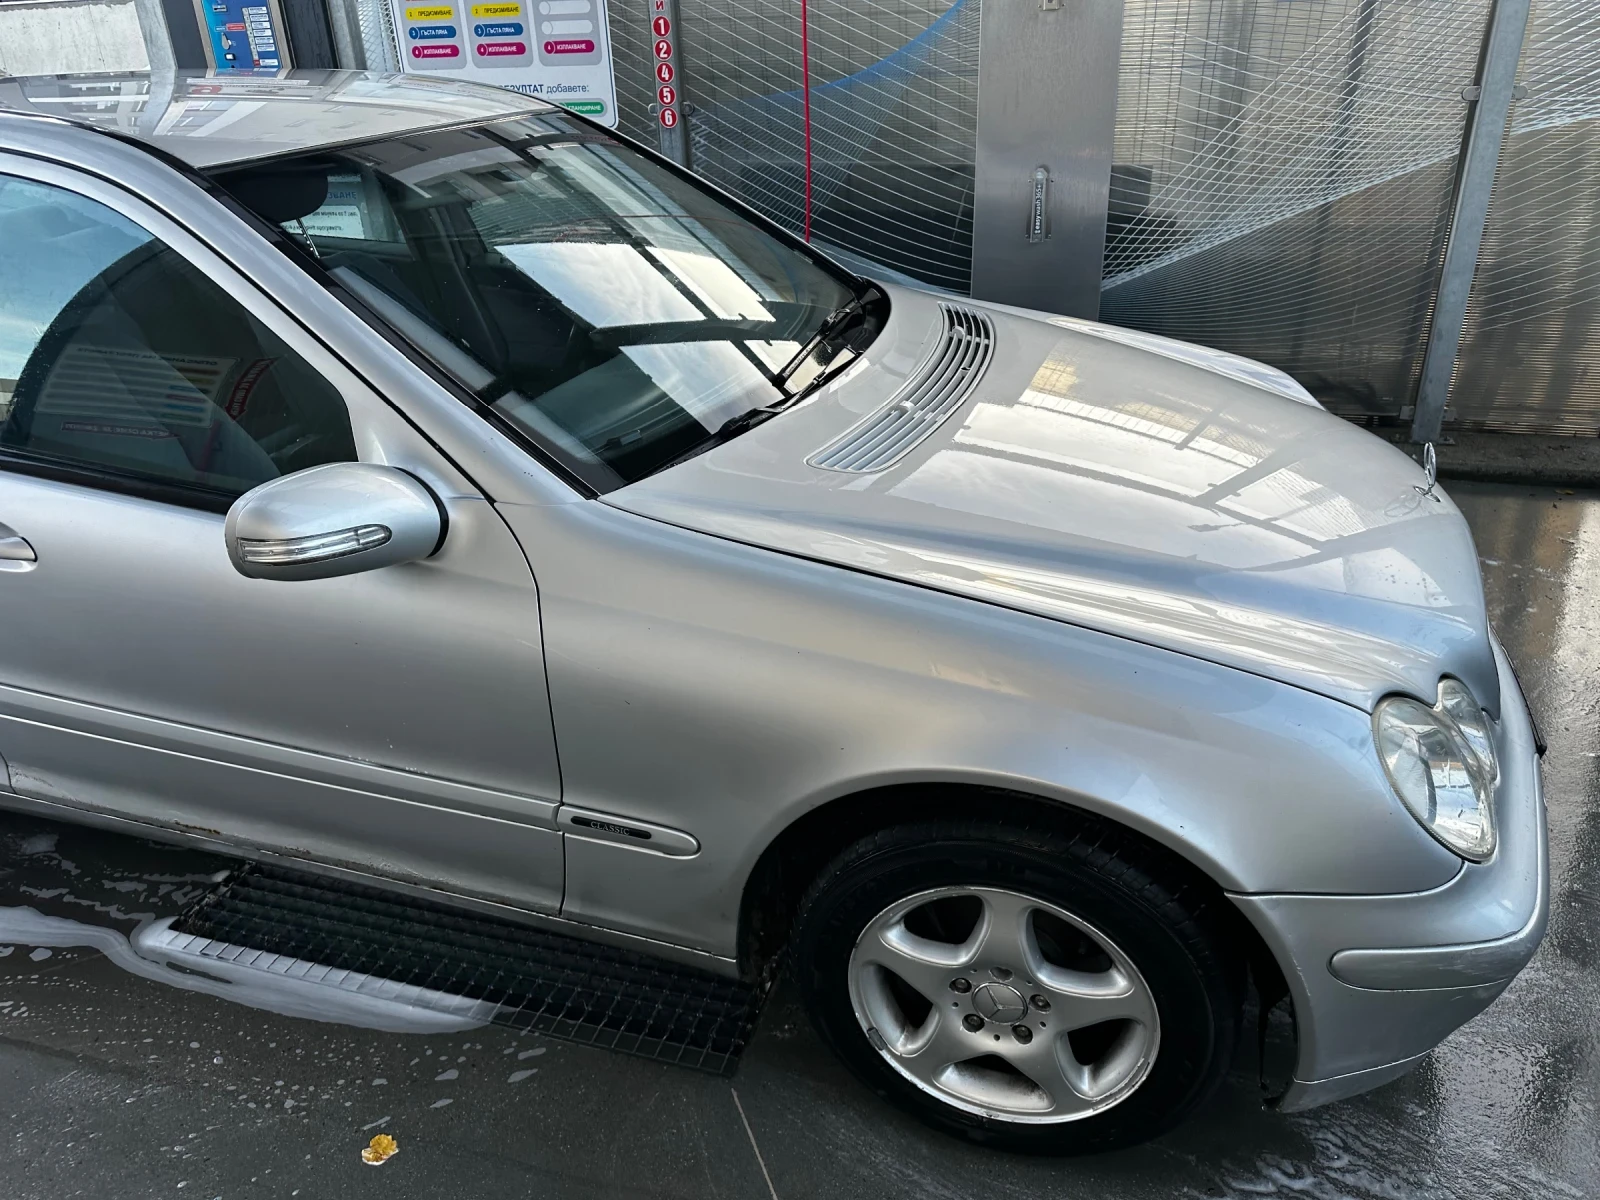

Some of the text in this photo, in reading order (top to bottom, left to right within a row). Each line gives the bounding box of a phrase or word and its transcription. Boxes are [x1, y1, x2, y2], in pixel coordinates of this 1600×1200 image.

[658, 18, 665, 35] 1
[659, 42, 668, 58] 2
[661, 65, 670, 81] 4
[546, 84, 589, 94] добавете:
[663, 88, 671, 103] 5
[664, 110, 672, 126] 6
[327, 192, 356, 200] ЗВАНЕ
[590, 821, 630, 836] CLASSIC
